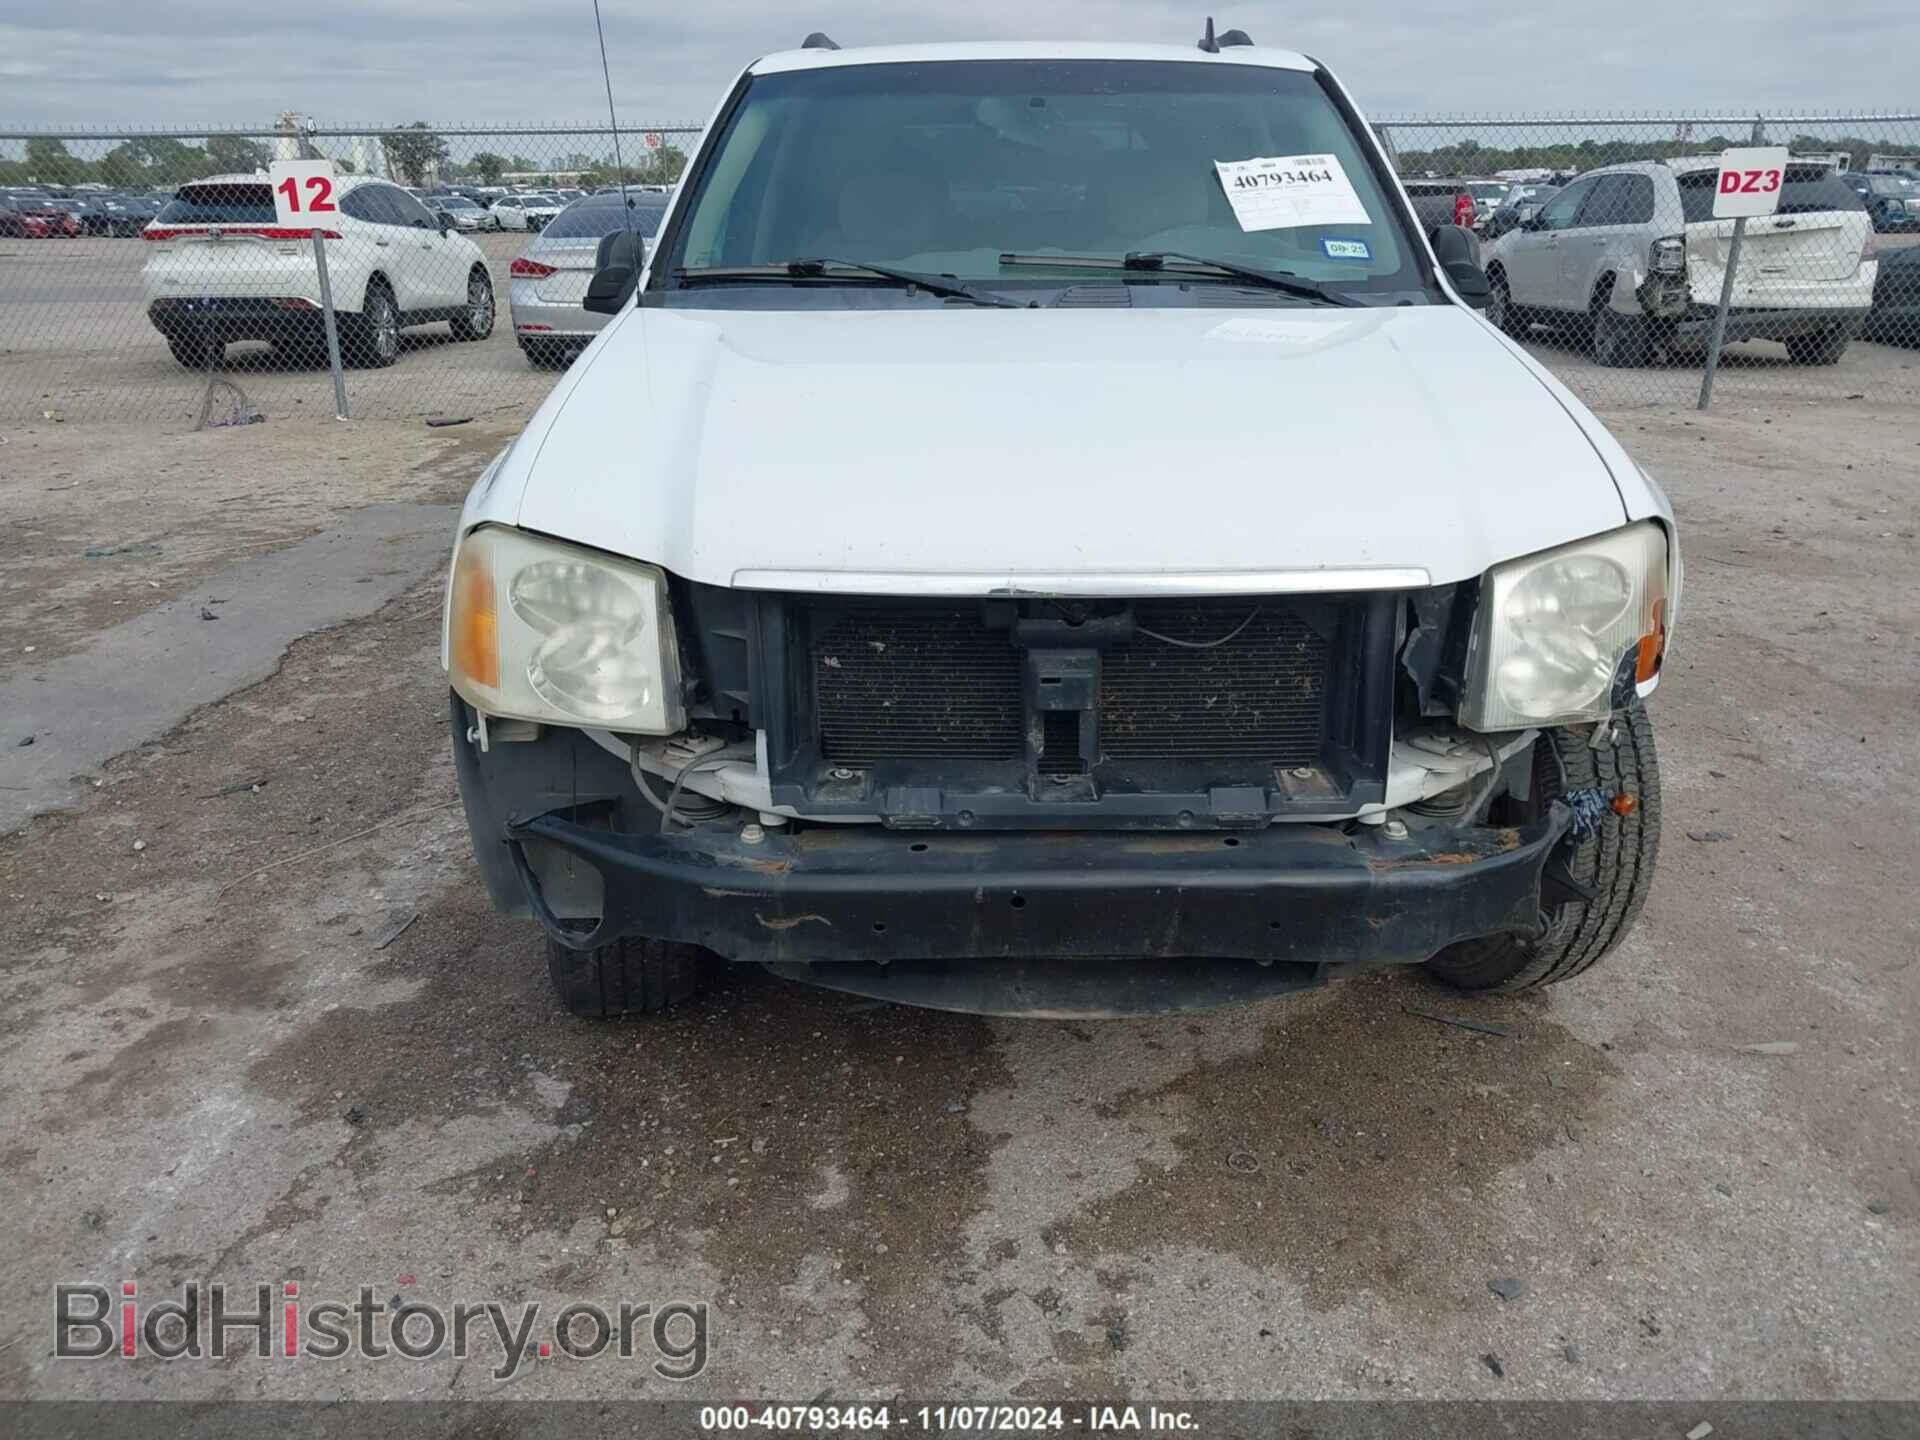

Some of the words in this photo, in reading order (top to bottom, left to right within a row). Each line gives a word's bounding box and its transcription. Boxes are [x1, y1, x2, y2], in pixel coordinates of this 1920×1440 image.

[1234, 169, 1332, 188] 40793464
[1720, 169, 1780, 193] DZ3
[278, 176, 336, 212] 12
